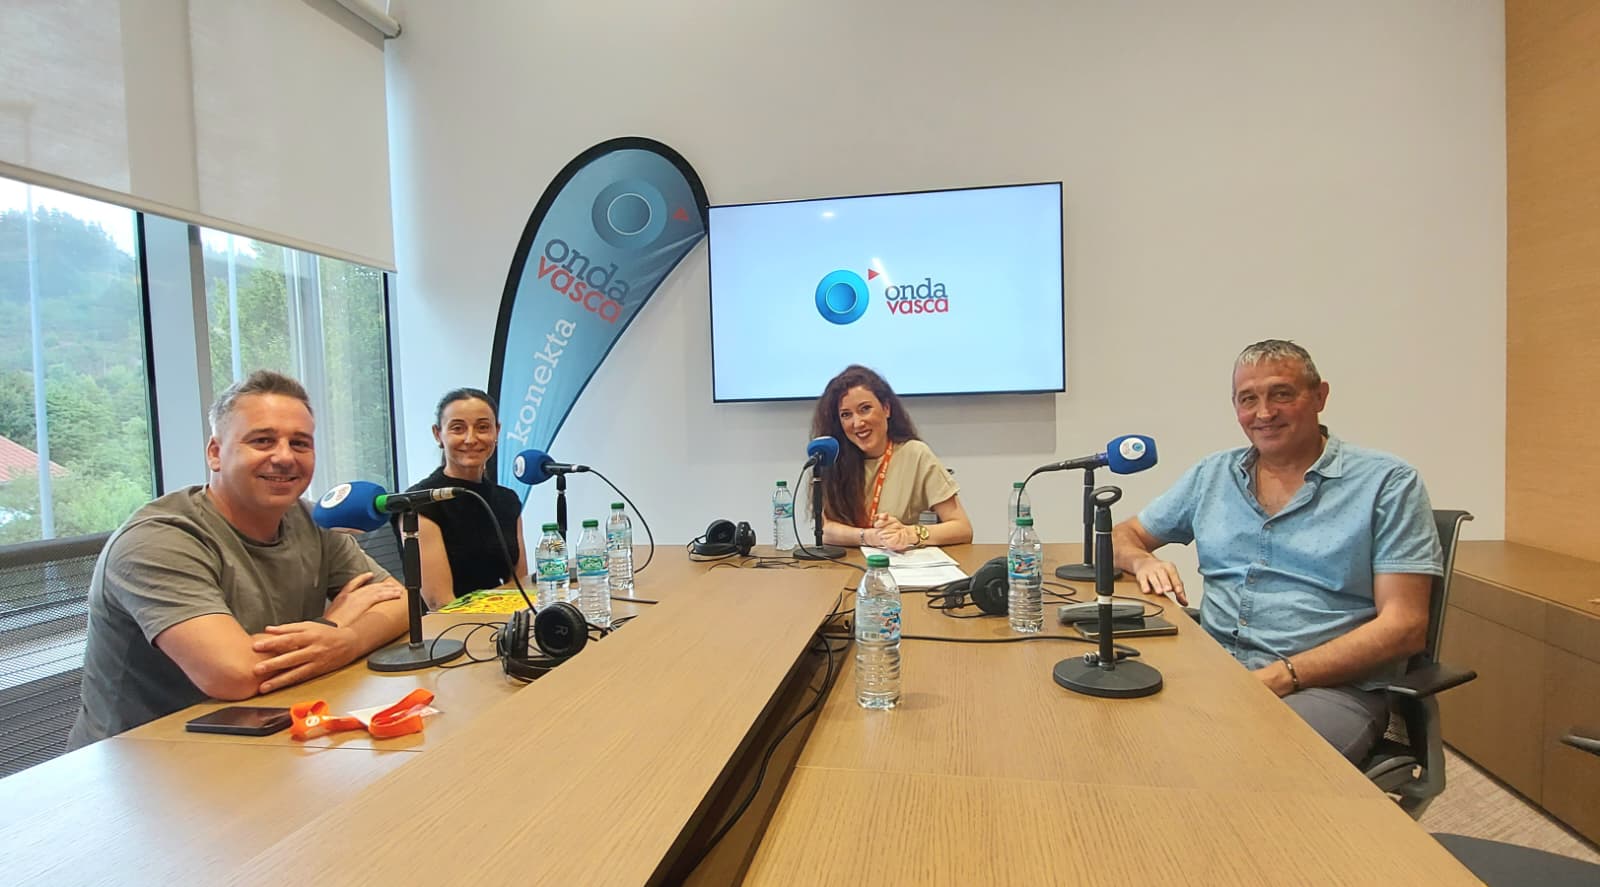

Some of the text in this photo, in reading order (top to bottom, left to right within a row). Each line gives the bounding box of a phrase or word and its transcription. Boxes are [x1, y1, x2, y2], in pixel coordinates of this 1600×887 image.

[538, 256, 624, 324] vasca
[545, 239, 630, 305] onda
[885, 277, 948, 301] onda
[886, 298, 949, 315] vasca
[506, 319, 577, 446] konekta
[555, 624, 569, 638] R
